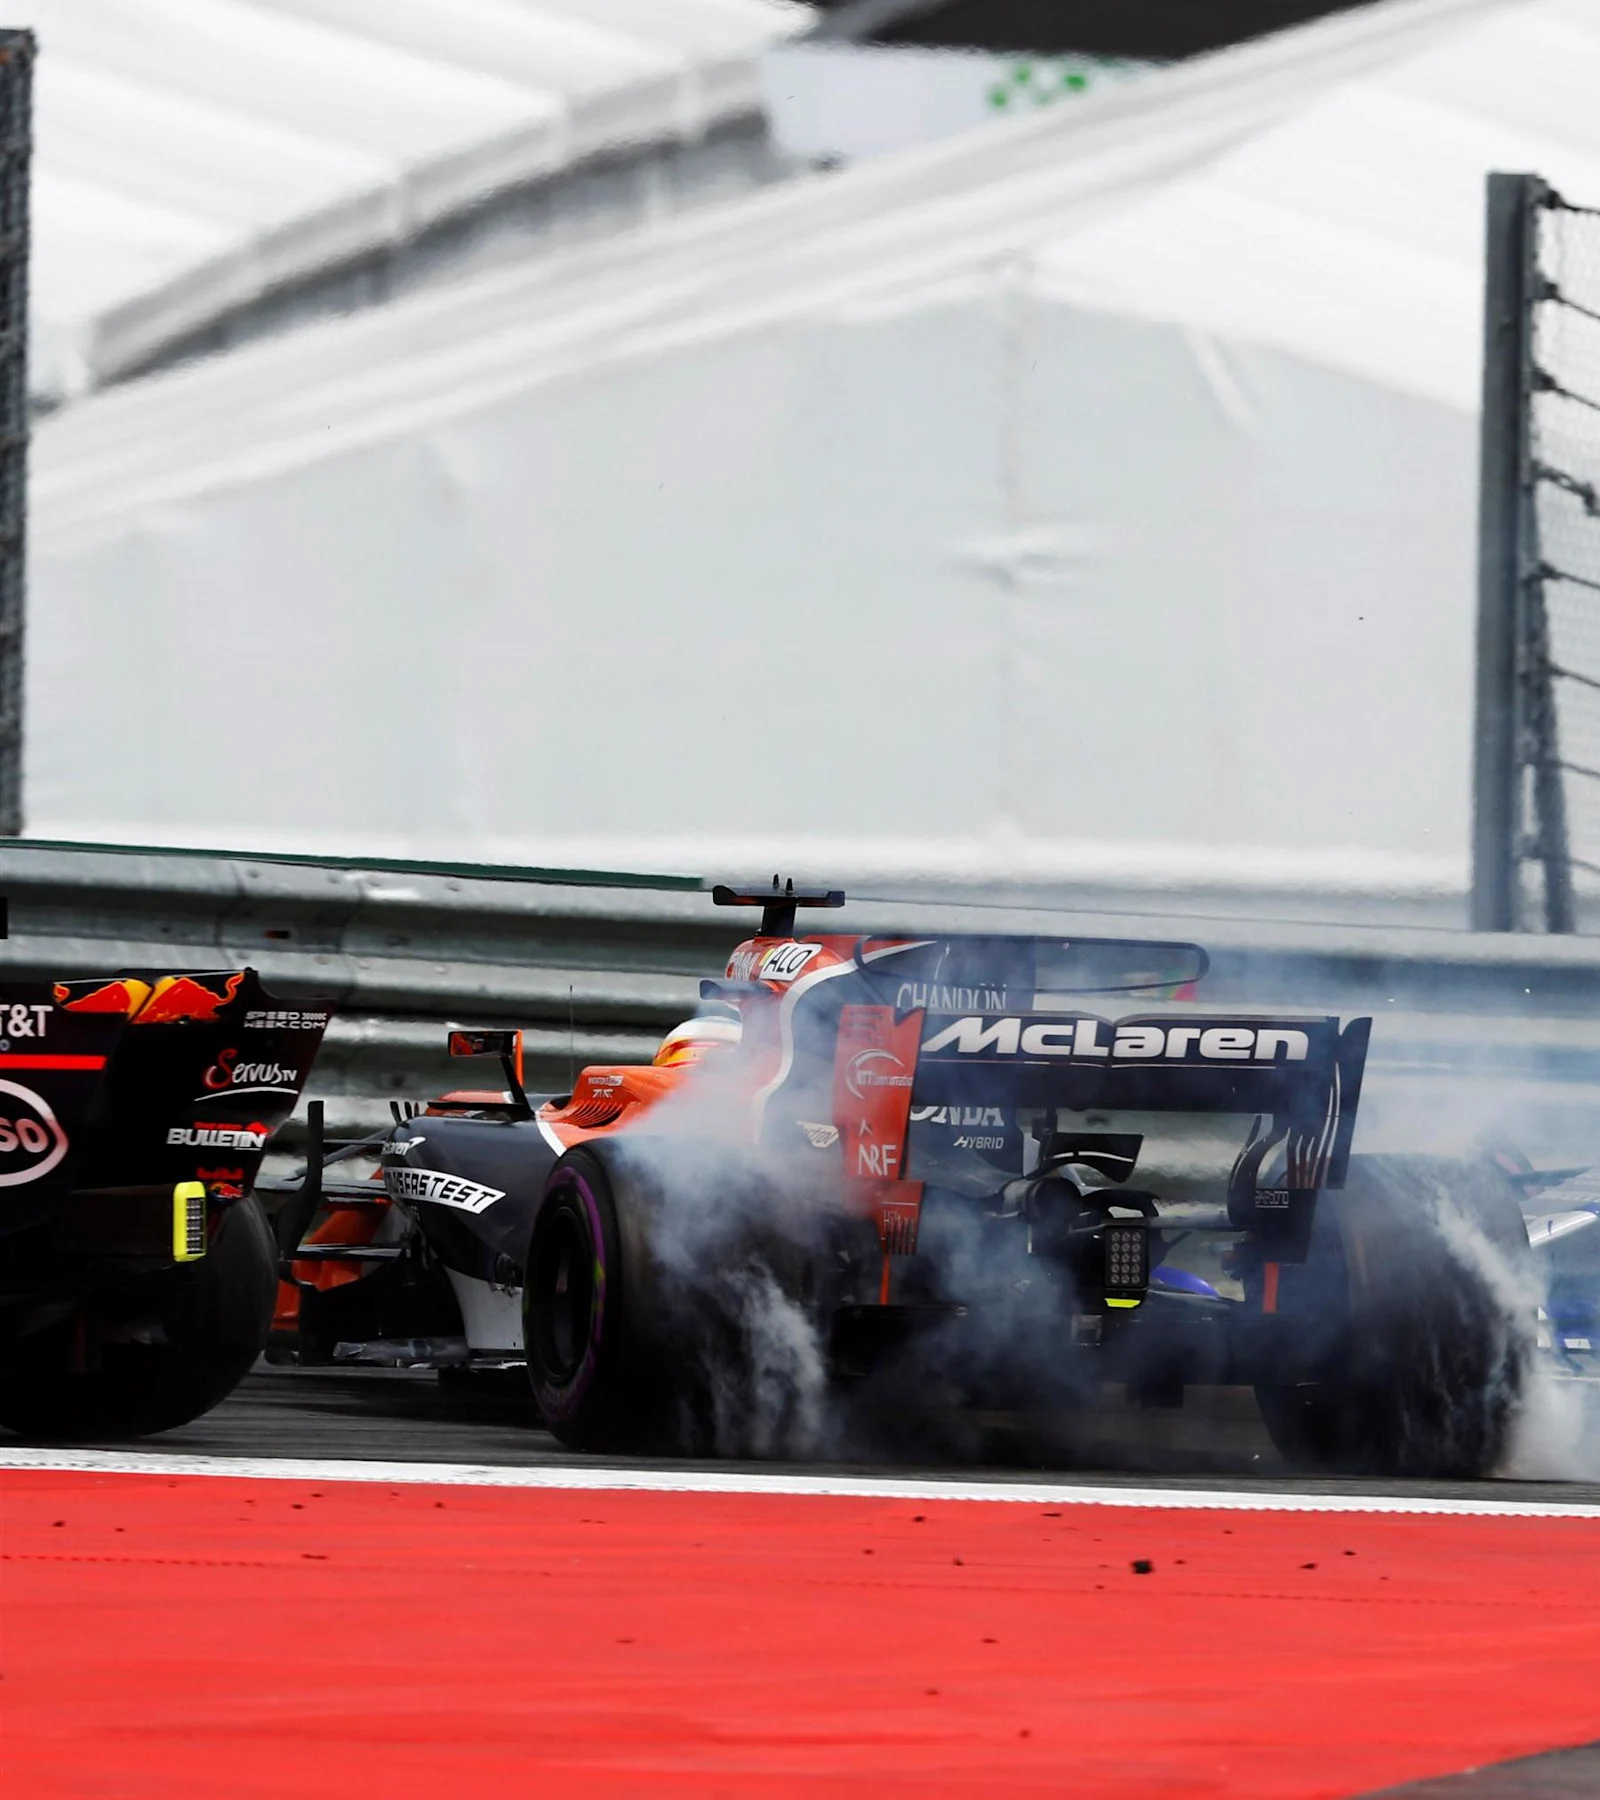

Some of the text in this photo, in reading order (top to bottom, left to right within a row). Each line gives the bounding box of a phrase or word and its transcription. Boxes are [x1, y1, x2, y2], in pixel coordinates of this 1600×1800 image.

[763, 945, 813, 974] ALO
[920, 1016, 1309, 1060] McLaren
[166, 1128, 266, 1149] BULLETIN
[954, 1136, 1004, 1149] HYBRID
